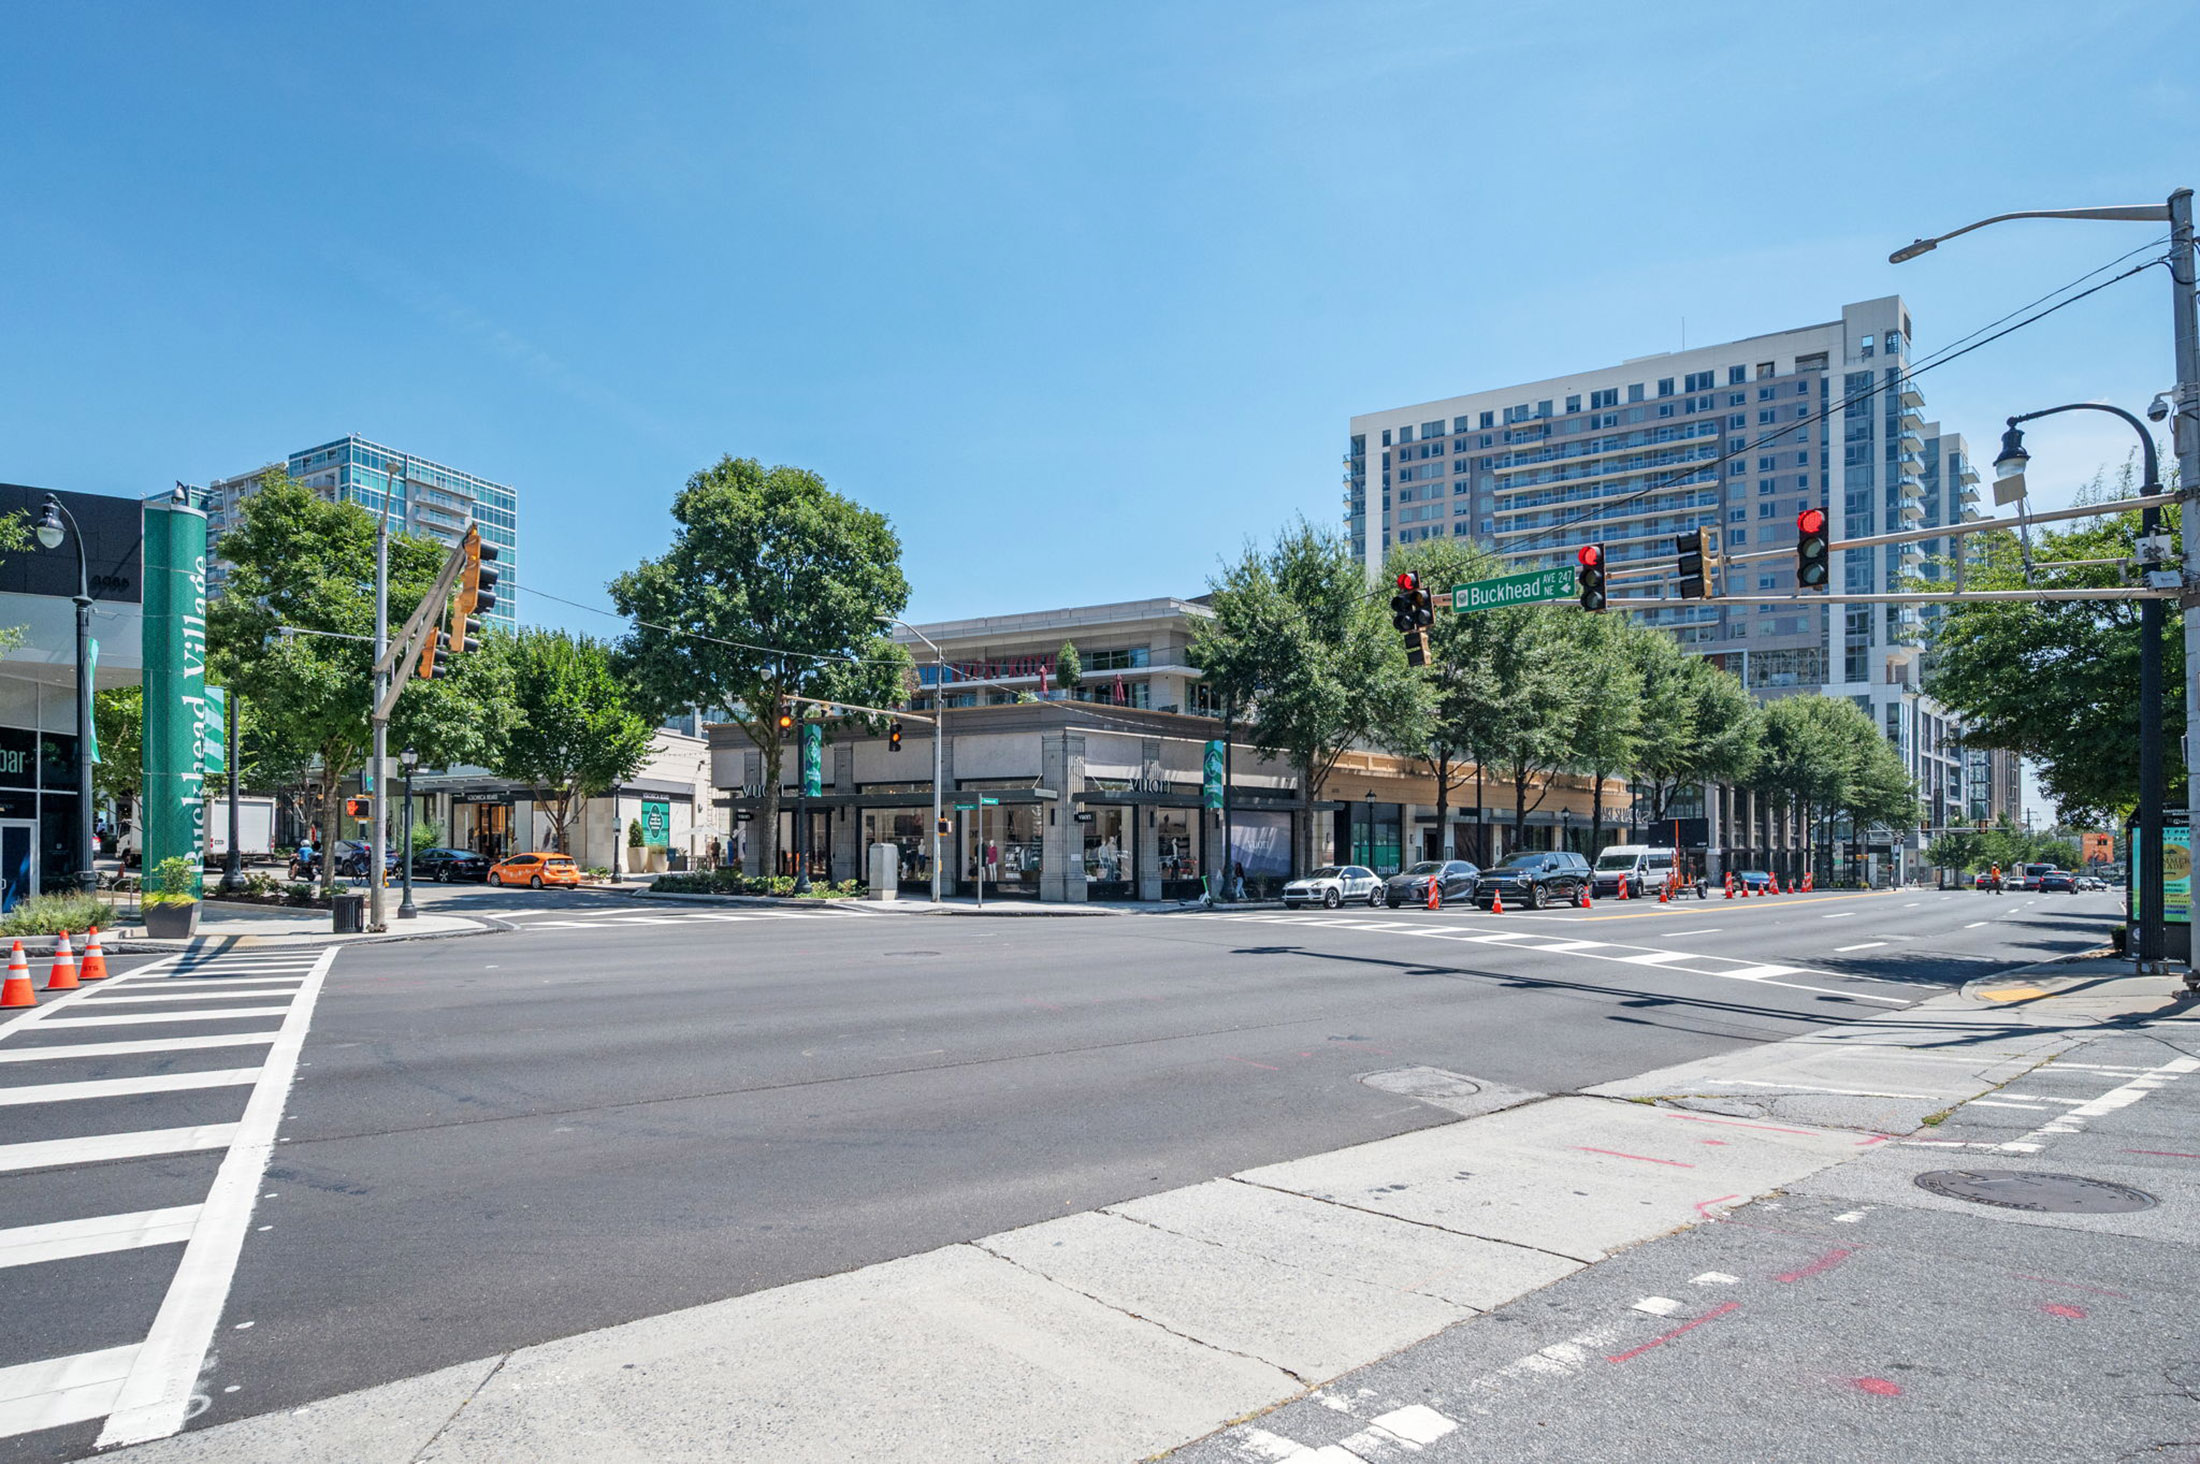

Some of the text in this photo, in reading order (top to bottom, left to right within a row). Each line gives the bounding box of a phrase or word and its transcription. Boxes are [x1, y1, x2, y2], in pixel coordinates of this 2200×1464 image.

[1542, 570, 1572, 584] AVE 247
[1471, 578, 1540, 606] Buckhead
[1544, 585, 1555, 596] NE
[181, 555, 206, 873] Buckhead Village
[743, 784, 784, 798] vui
